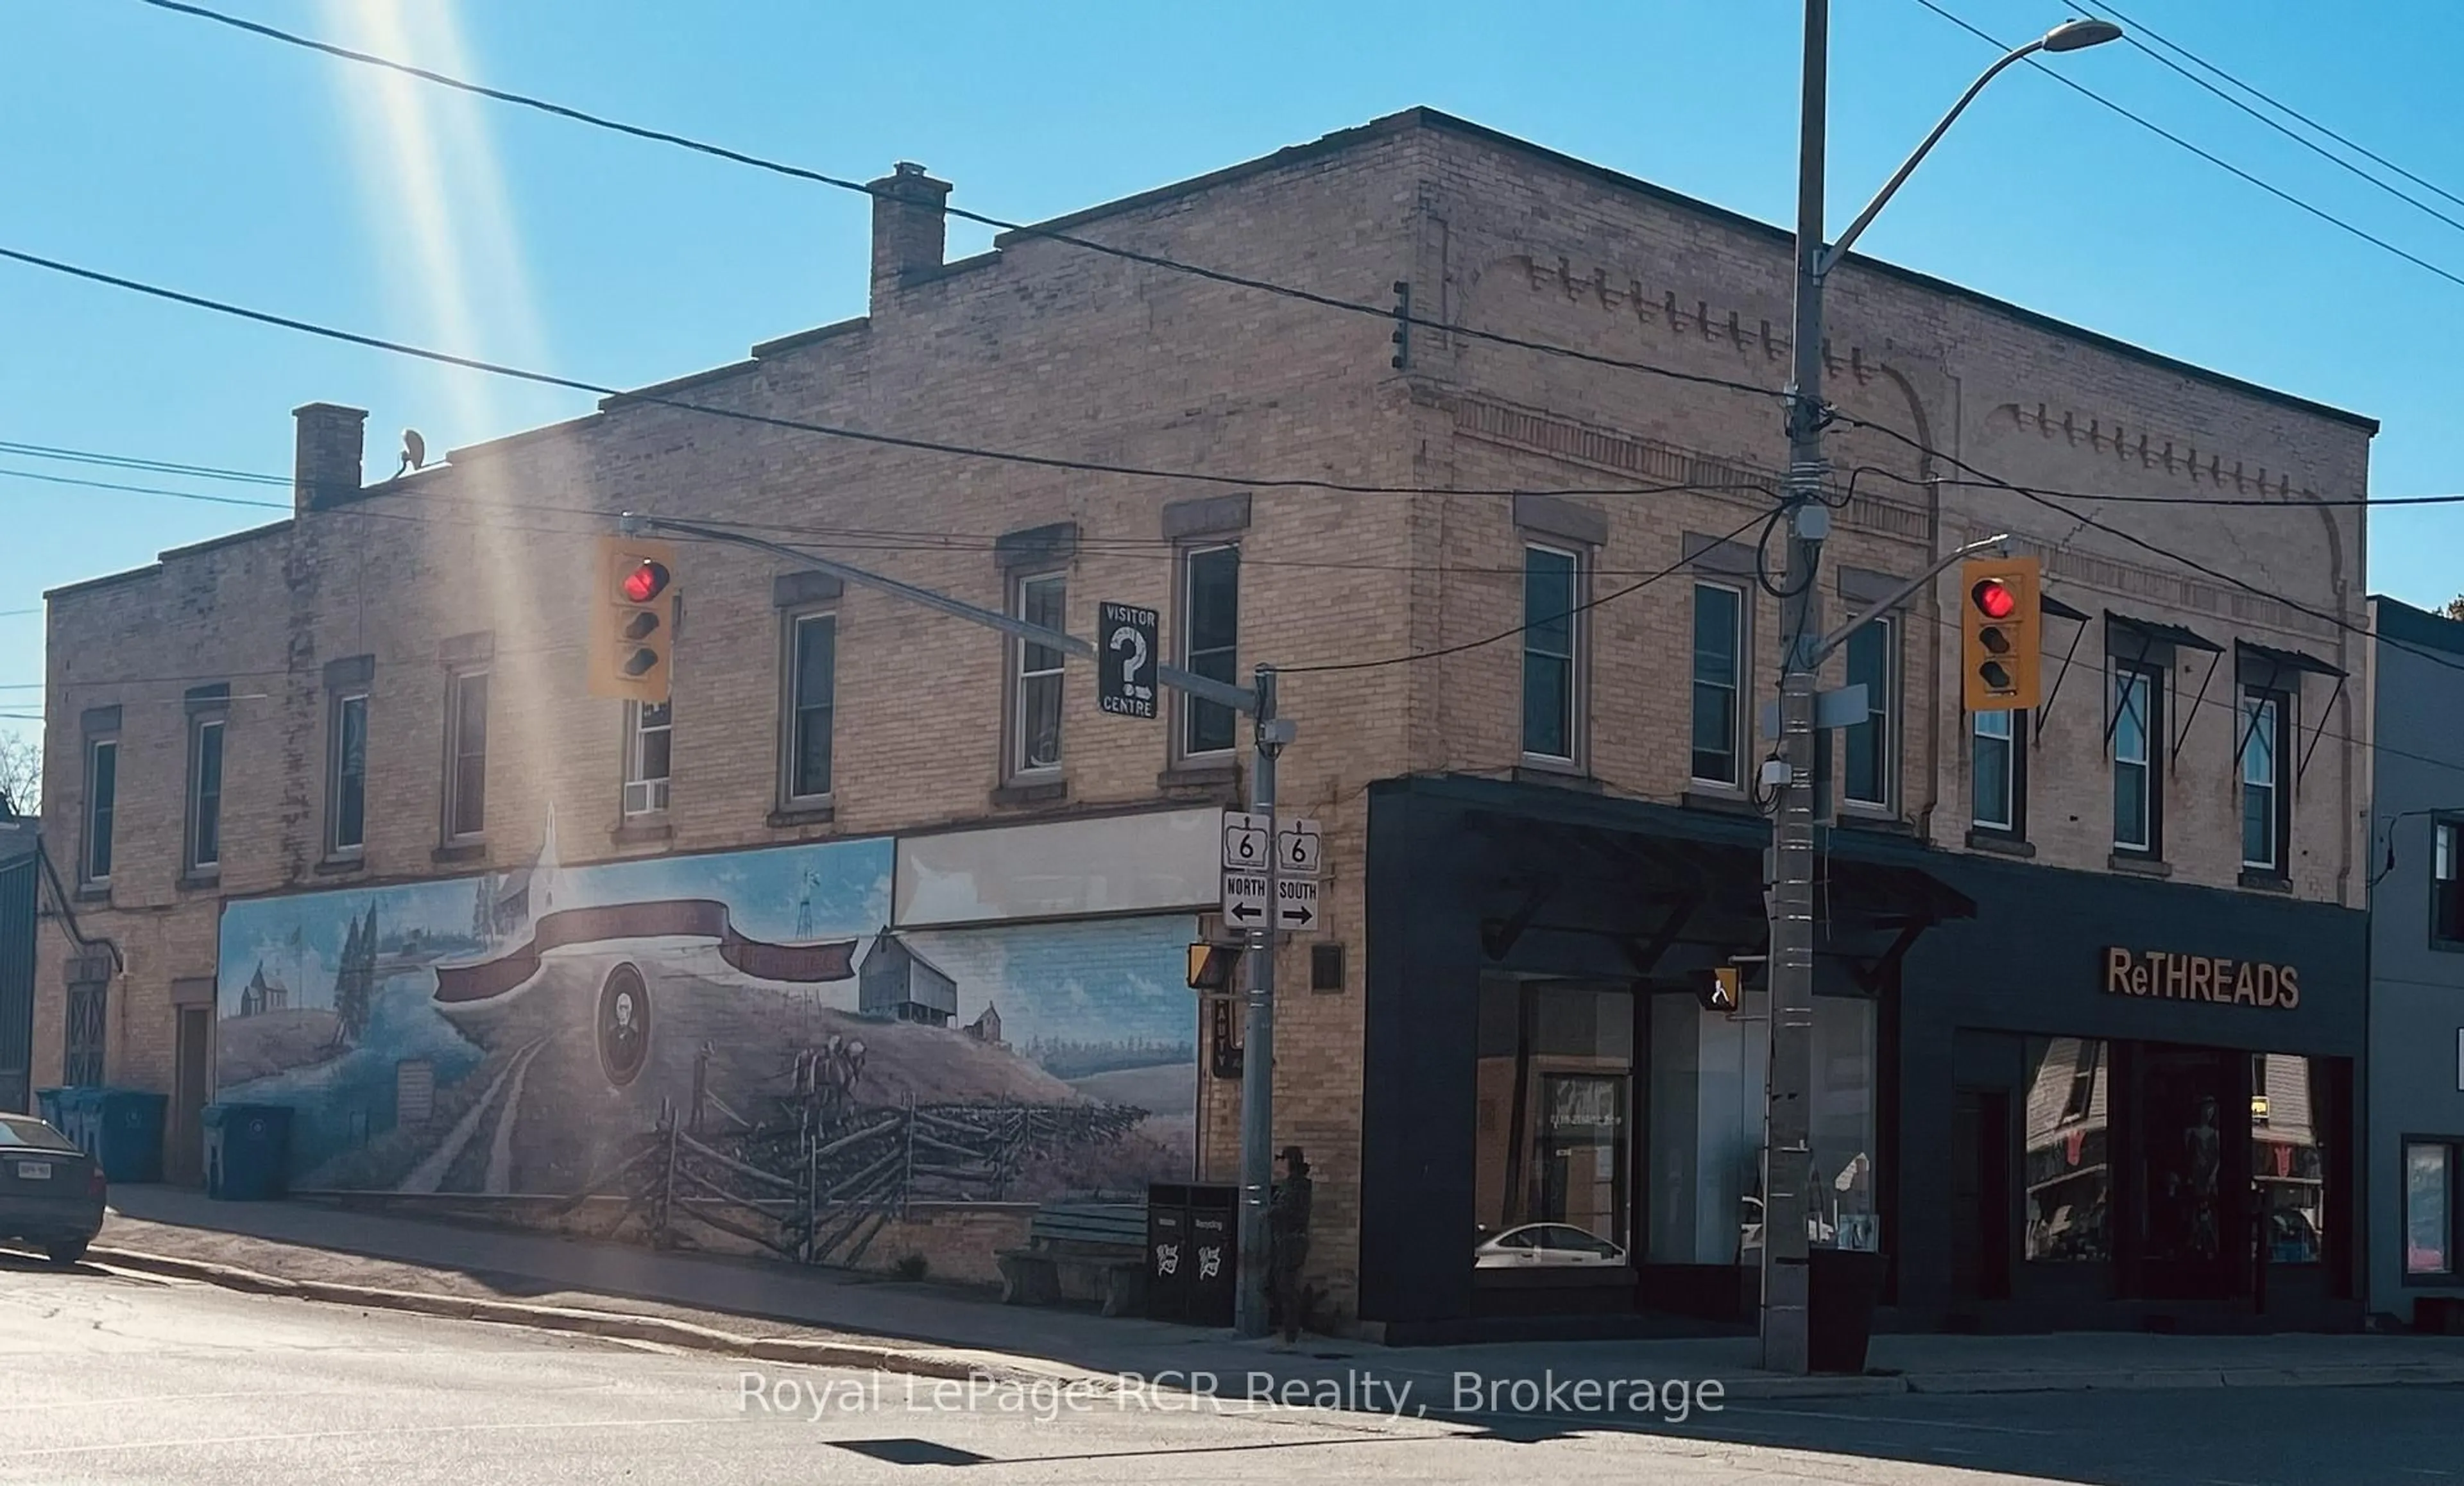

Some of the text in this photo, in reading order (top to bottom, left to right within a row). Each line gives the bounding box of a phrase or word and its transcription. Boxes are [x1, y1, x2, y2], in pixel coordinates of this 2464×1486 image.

[1106, 605, 1156, 627] VISITOR
[1103, 695, 1152, 717] CENTRE
[1239, 833, 1253, 858] 6
[1292, 838, 1306, 862] 6
[1228, 877, 1265, 896] NORTH
[1279, 882, 1316, 900] SOUTH
[2109, 946, 2299, 1009] ReTHREADS
